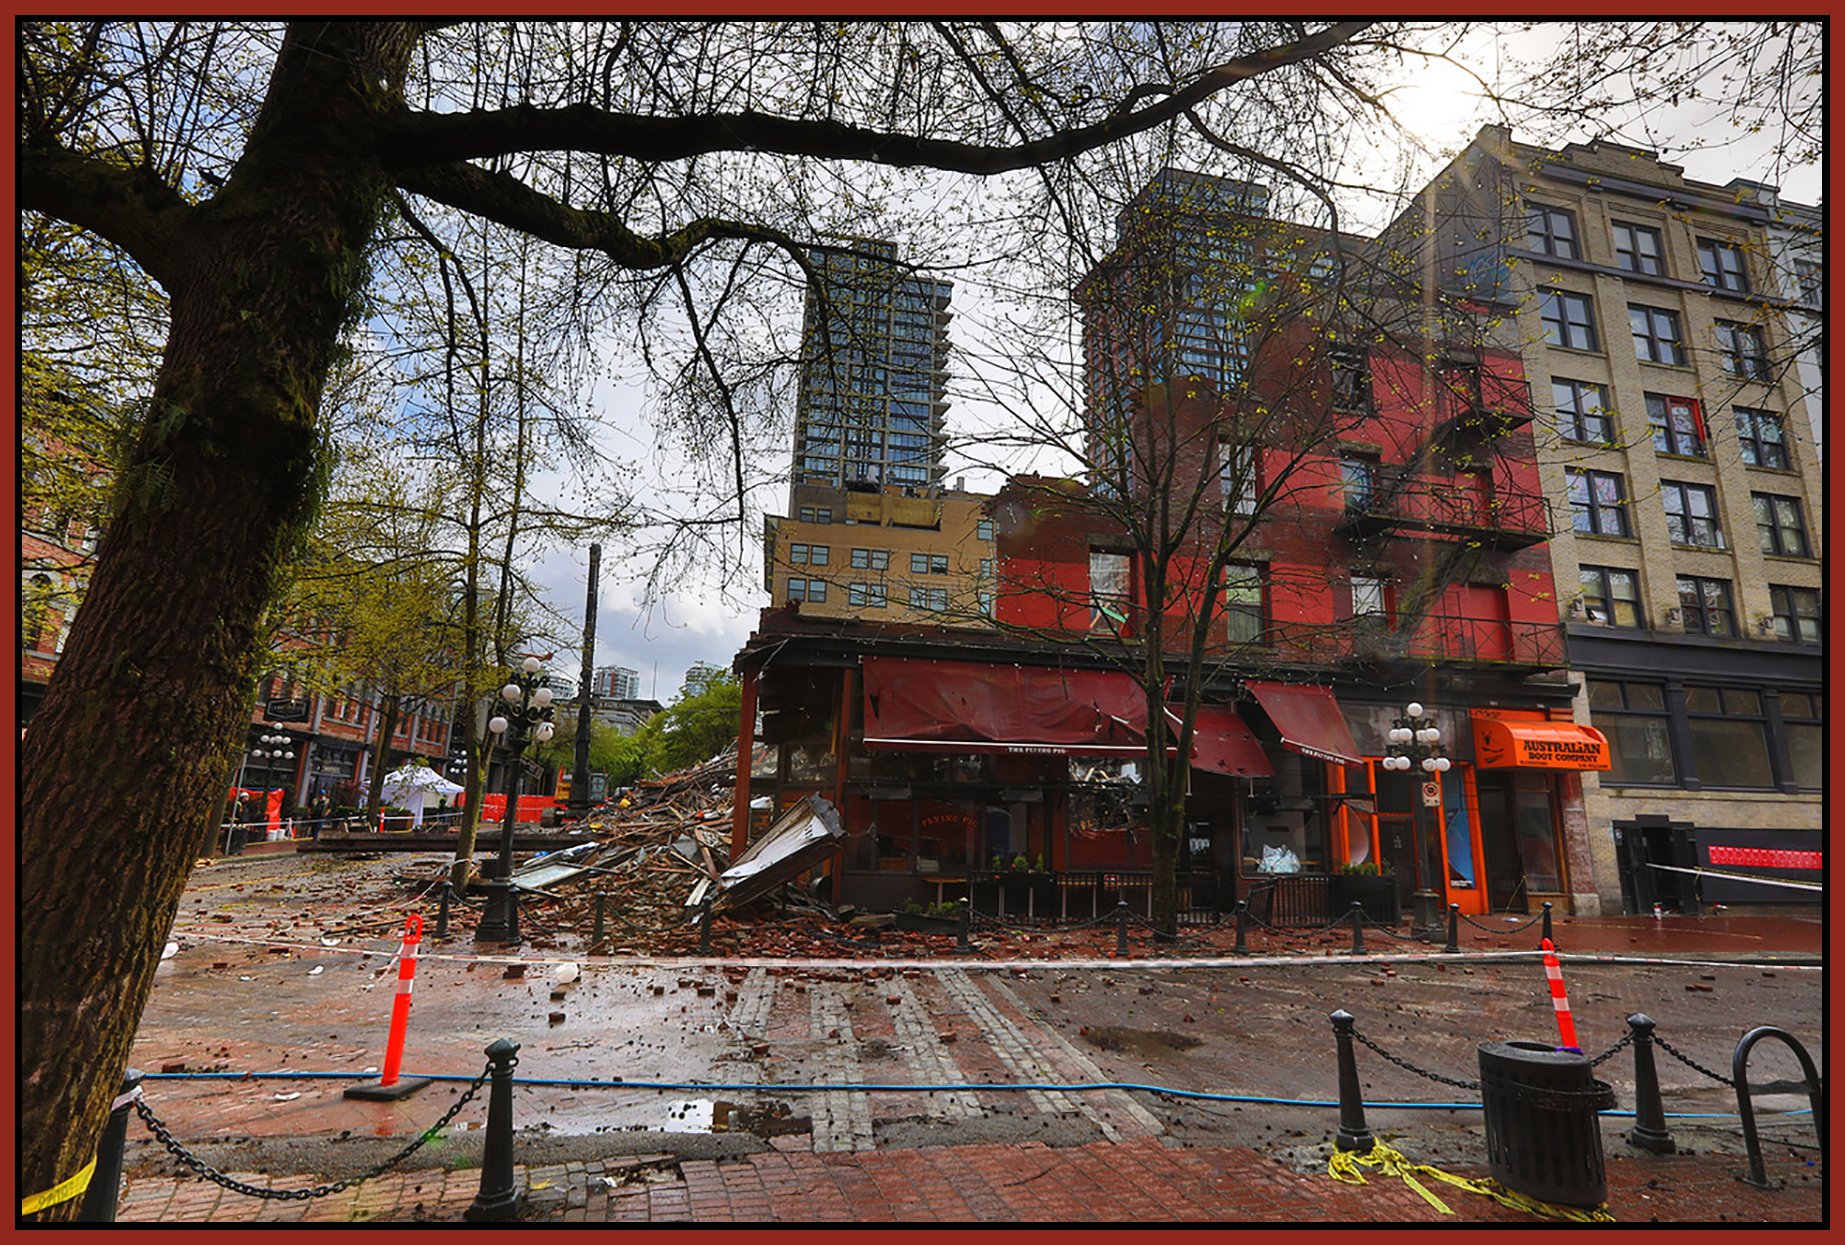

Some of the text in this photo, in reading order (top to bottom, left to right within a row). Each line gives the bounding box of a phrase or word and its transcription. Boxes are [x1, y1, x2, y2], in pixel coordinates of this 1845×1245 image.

[1528, 752, 1552, 760] BOOT
[1555, 753, 1597, 762] COMPANY
[920, 815, 977, 828] FLYING PIG
